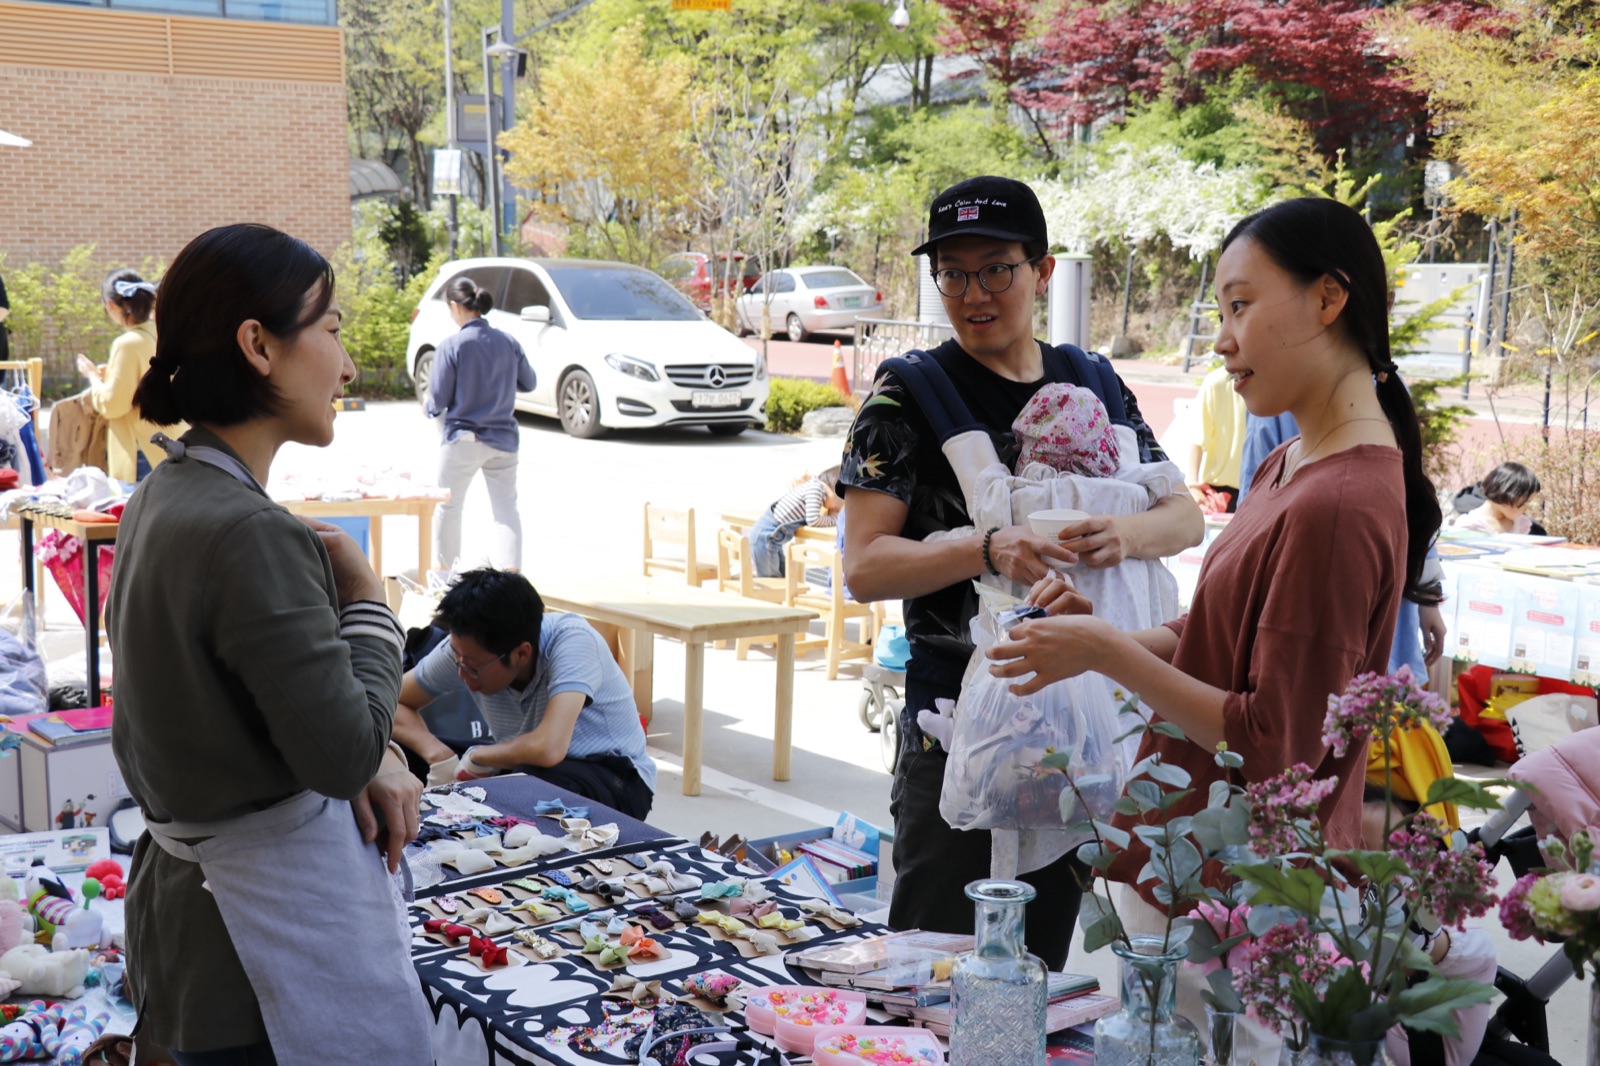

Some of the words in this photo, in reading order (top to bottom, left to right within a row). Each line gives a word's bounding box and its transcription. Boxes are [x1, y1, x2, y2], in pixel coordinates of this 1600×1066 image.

[954, 199, 972, 208] Calm
[974, 197, 989, 205] And
[991, 199, 1007, 208] Love
